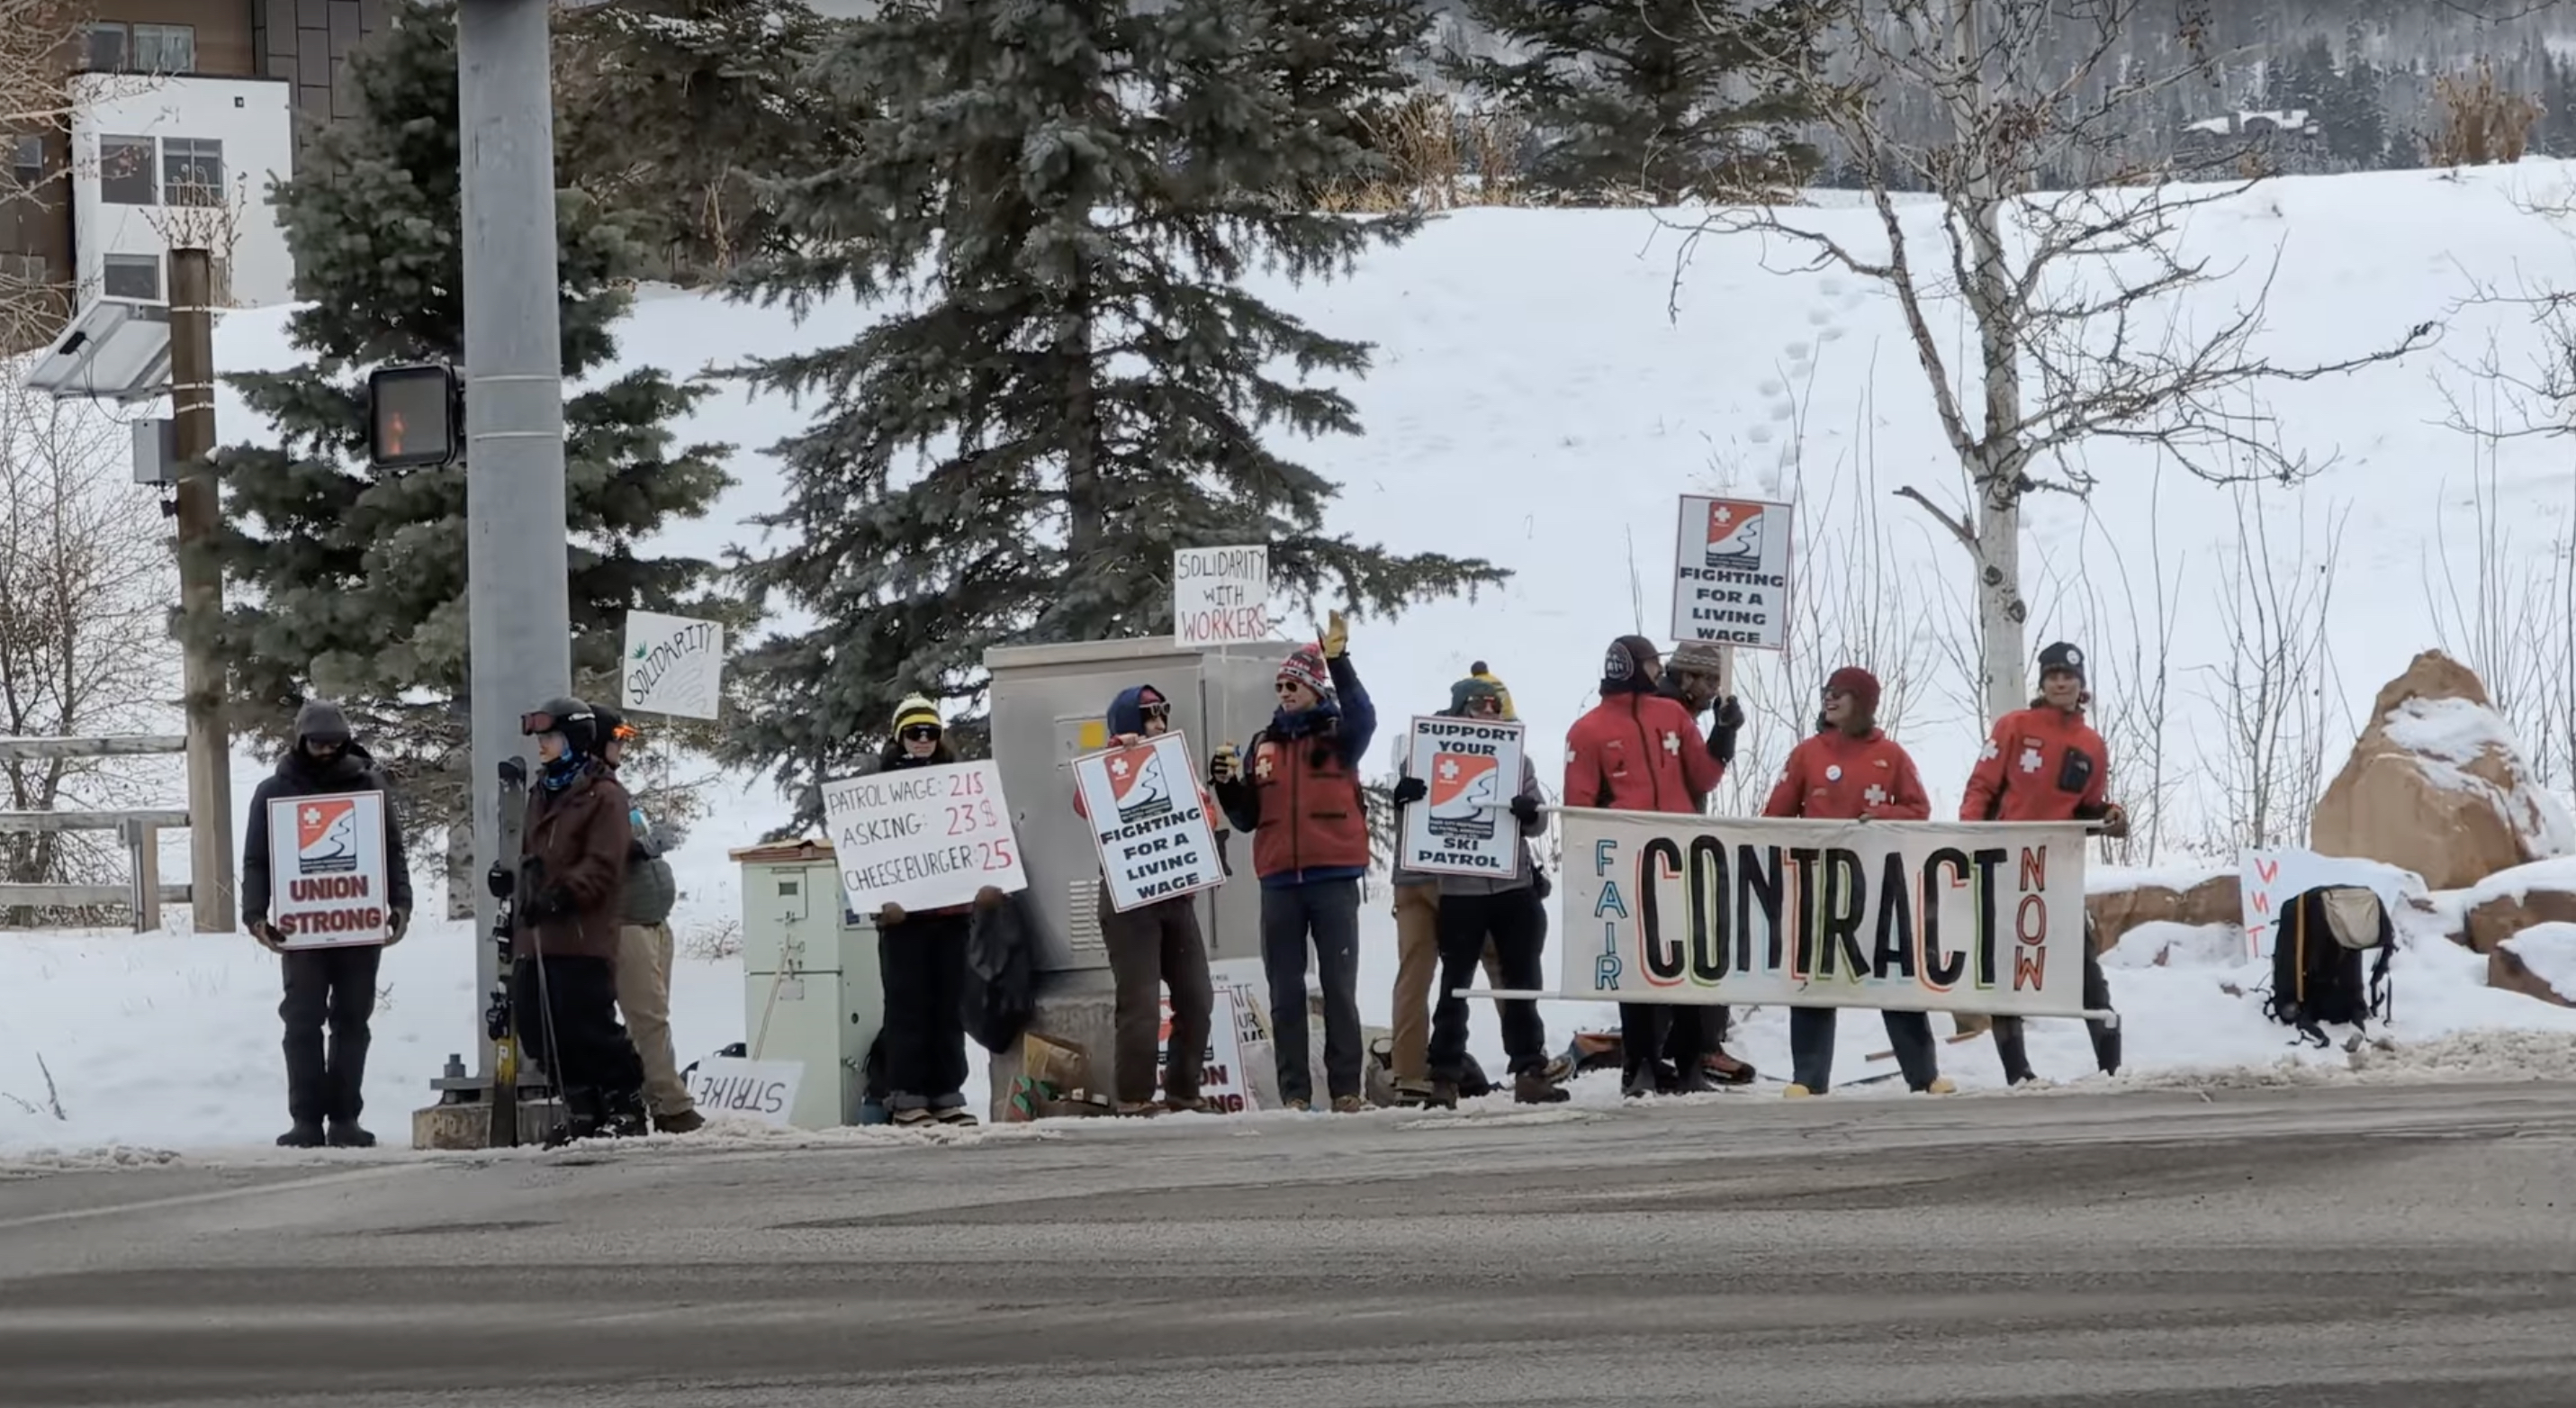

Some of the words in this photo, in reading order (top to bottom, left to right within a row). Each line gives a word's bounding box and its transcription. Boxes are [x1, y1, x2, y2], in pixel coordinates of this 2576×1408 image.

[1178, 550, 1265, 581] SOLIDARITY
[1680, 567, 1784, 588] FIGHTING
[1203, 586, 1243, 606] WITH
[1697, 588, 1743, 603] FOR
[1748, 593, 1763, 606] A
[1182, 603, 1266, 641] WORKERS
[1692, 608, 1766, 625] LIVING
[1696, 627, 1761, 644] WAGE
[628, 622, 716, 705] SOLIDARITY
[1418, 723, 1518, 741] SUPPORT
[1438, 741, 1497, 755] YOUR
[828, 784, 887, 815] PATROL
[888, 777, 942, 802] WAGE:
[1100, 808, 1202, 845] FIGHTING
[978, 838, 1013, 871] 25
[1123, 838, 1168, 861] FOR
[1174, 833, 1189, 846] A
[1444, 838, 1479, 851] SKI
[1126, 852, 1198, 881] LIVING
[1419, 850, 1500, 868] PATROL
[290, 875, 368, 902] UNION
[1137, 872, 1200, 899] WAGE
[279, 907, 382, 935] STRONG
[1594, 839, 1628, 990] FAIR
[1635, 835, 2008, 991] CONTRACT
[2013, 844, 2048, 991] NOW
[695, 1077, 786, 1114] STRIKE
